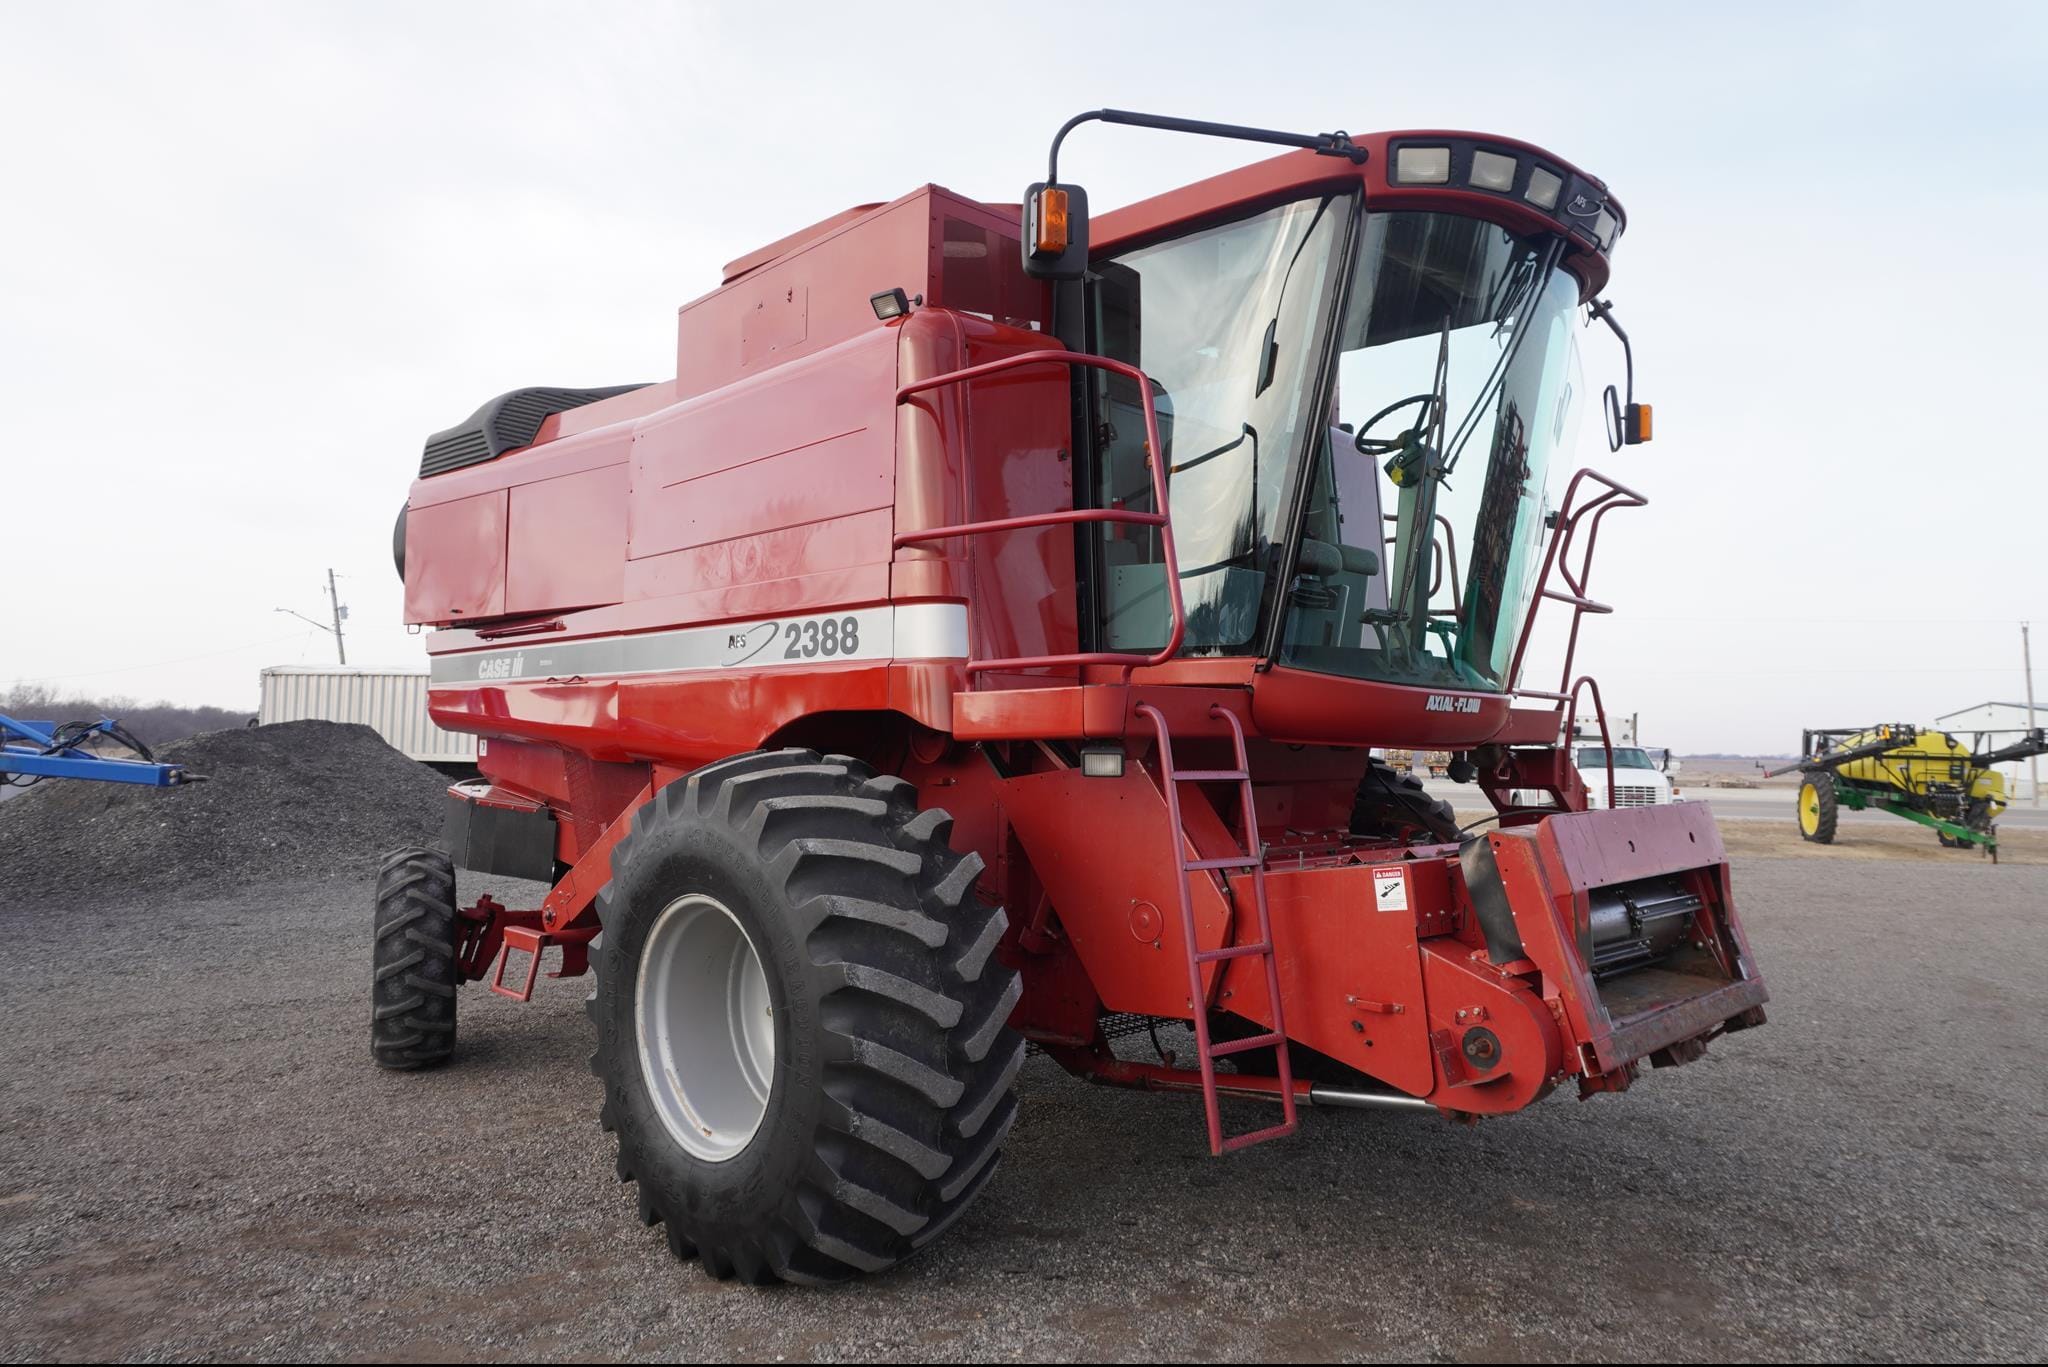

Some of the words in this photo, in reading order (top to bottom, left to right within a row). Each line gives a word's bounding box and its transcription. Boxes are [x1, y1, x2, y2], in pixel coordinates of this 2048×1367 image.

[728, 634, 746, 648] AFS
[783, 616, 859, 659] 2388
[479, 658, 511, 679] CASE
[1425, 695, 1481, 713] AXIAL-FLOW
